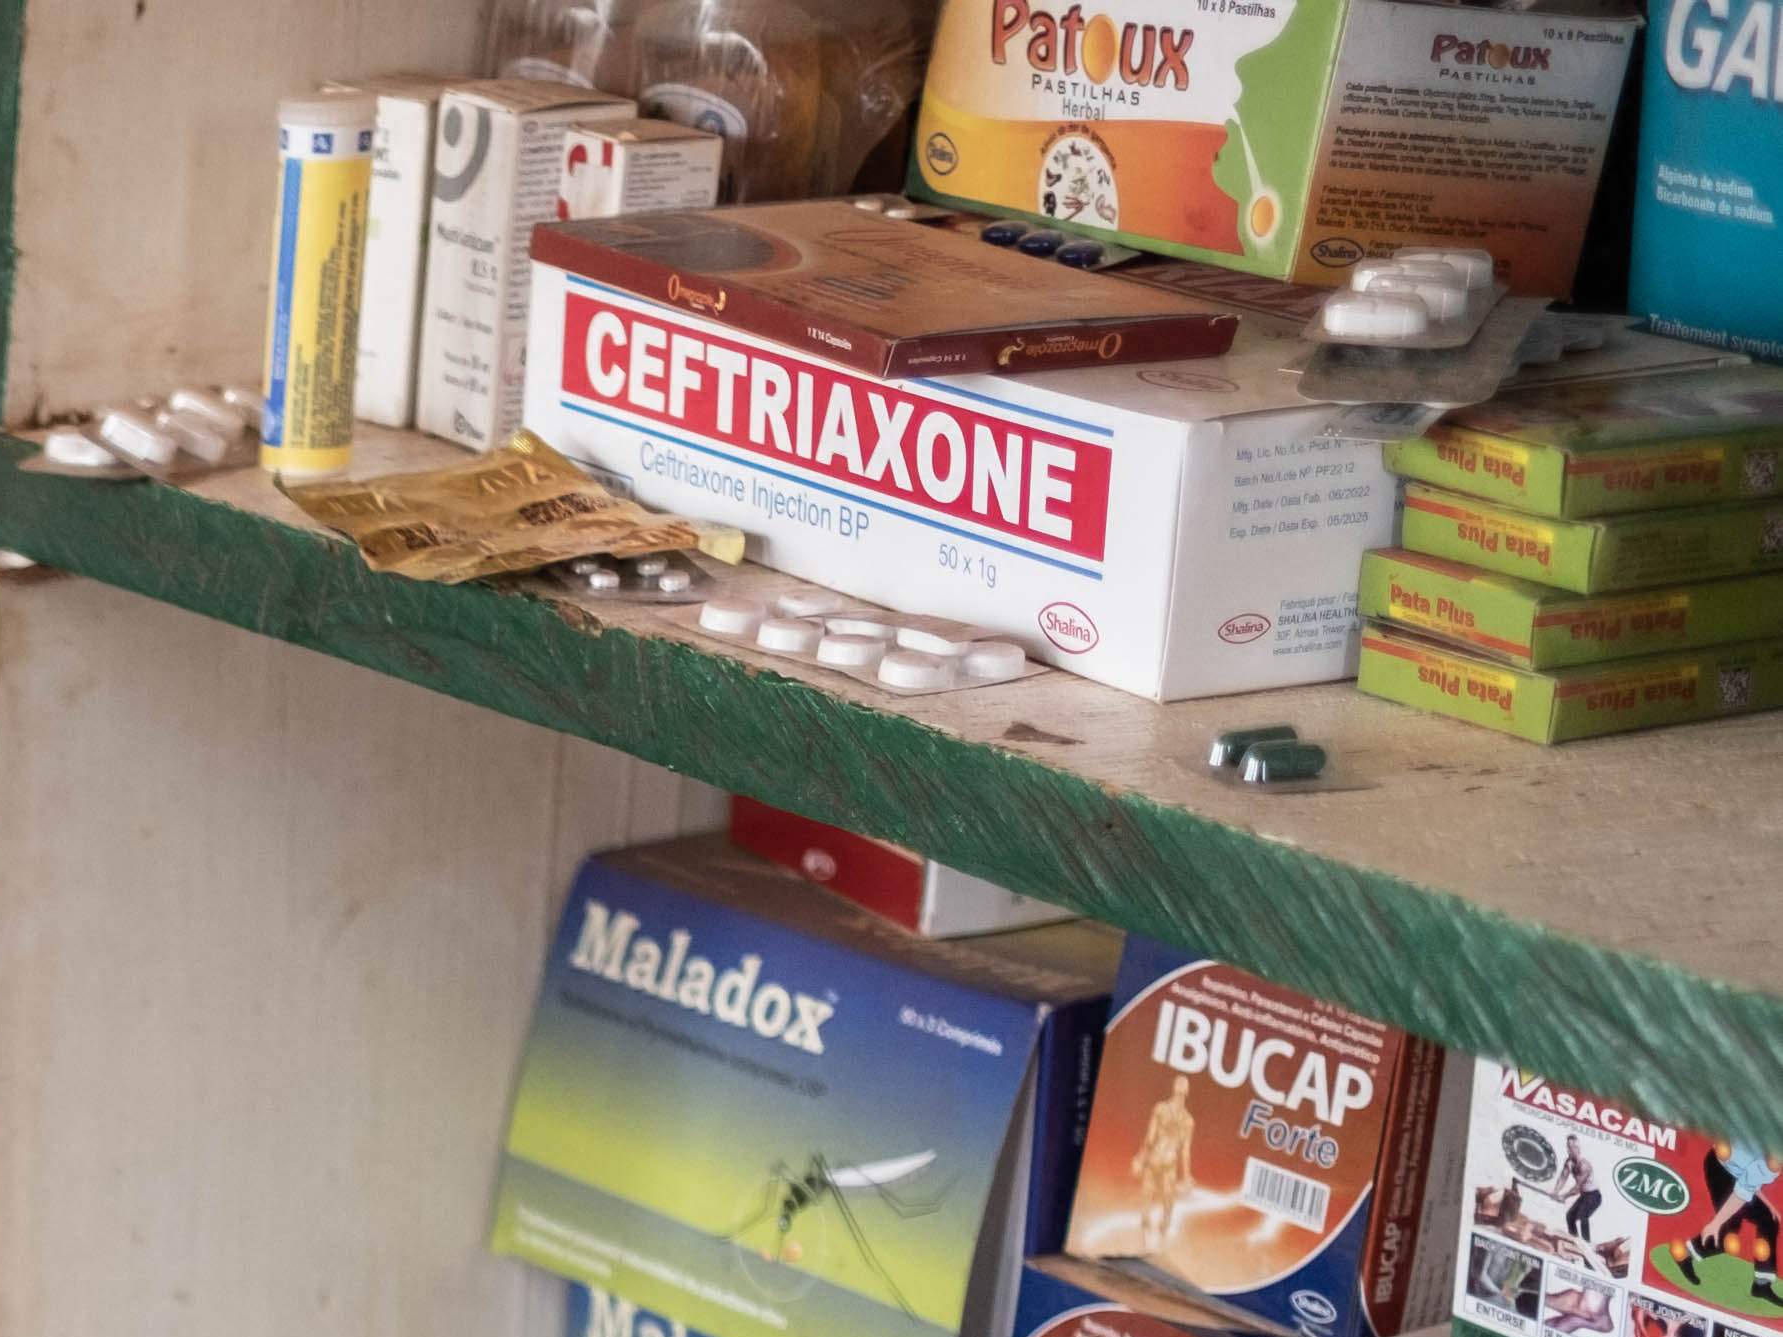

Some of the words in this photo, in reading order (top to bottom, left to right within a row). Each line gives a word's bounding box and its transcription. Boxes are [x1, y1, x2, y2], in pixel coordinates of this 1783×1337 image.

[991, 0, 1194, 91] Patoux
[1430, 34, 1552, 71] Patoux
[1665, 0, 1783, 104] GA
[1031, 73, 1142, 106] PASTILHAS
[1438, 68, 1537, 85] PASTILHAS
[1062, 99, 1106, 122] Herbal
[1658, 164, 1698, 188] Alginate
[1700, 176, 1712, 192] de
[1715, 178, 1754, 200] sodium
[1655, 185, 1716, 213] Bicarbonate
[1718, 199, 1732, 217] de
[1734, 201, 1774, 224] sodium
[1649, 313, 1727, 347] Traitement
[584, 310, 1077, 543] CEFTRIAXONE
[1437, 444, 1477, 473] Plus
[1482, 456, 1526, 487] Pata
[639, 440, 746, 503] Ceftriaxone
[752, 477, 833, 531] Injection
[839, 506, 870, 541] BP
[1457, 522, 1498, 553] Plus
[1506, 535, 1550, 567] Pata
[938, 543, 958, 569] 50
[963, 556, 973, 573] x
[978, 553, 998, 588] 1g
[1277, 610, 1318, 626] SHALINA
[1390, 583, 1430, 614] Pata
[1437, 597, 1475, 629] Plus
[1043, 610, 1093, 646] Shalina
[1223, 620, 1264, 637] Shalina
[1418, 664, 1460, 697] Plus
[1466, 679, 1513, 712] Pata
[569, 898, 836, 1057] Maladox
[1152, 999, 1374, 1128] IBUCAP
[1239, 1099, 1340, 1170] Forte
[1621, 1166, 1684, 1206] ZMC
[1374, 1221, 1401, 1305] IBUCAP
[1475, 1302, 1525, 1331] ENTORSE
